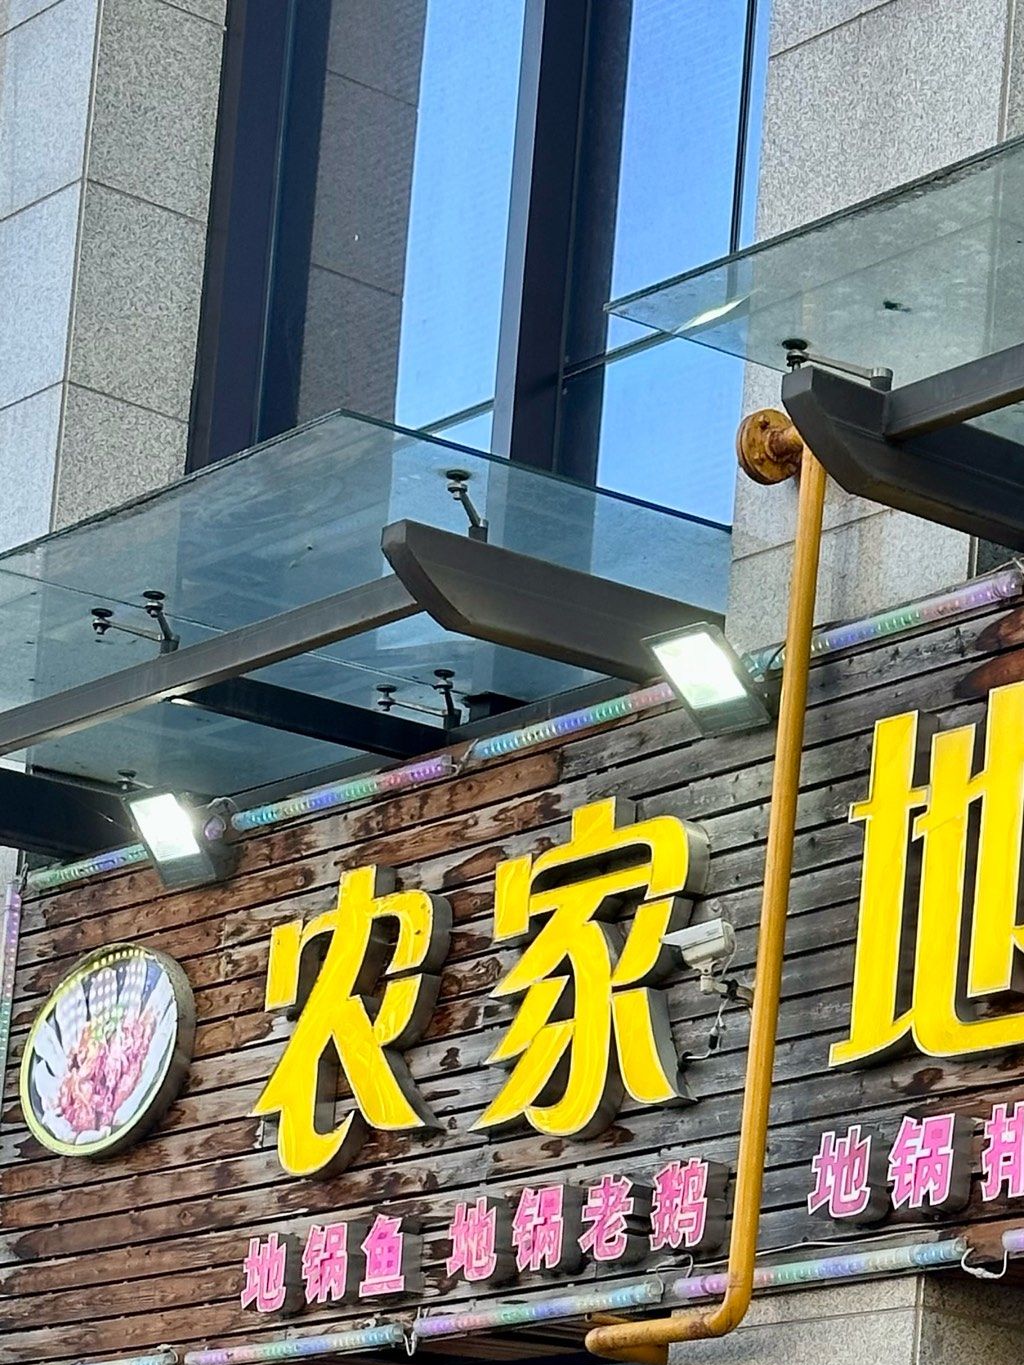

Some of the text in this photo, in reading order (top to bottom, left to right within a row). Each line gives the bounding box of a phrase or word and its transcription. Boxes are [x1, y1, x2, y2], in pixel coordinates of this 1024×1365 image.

[241, 1213, 405, 1313] 地锅鱼
[446, 1157, 708, 1281] 地锅老鹅
